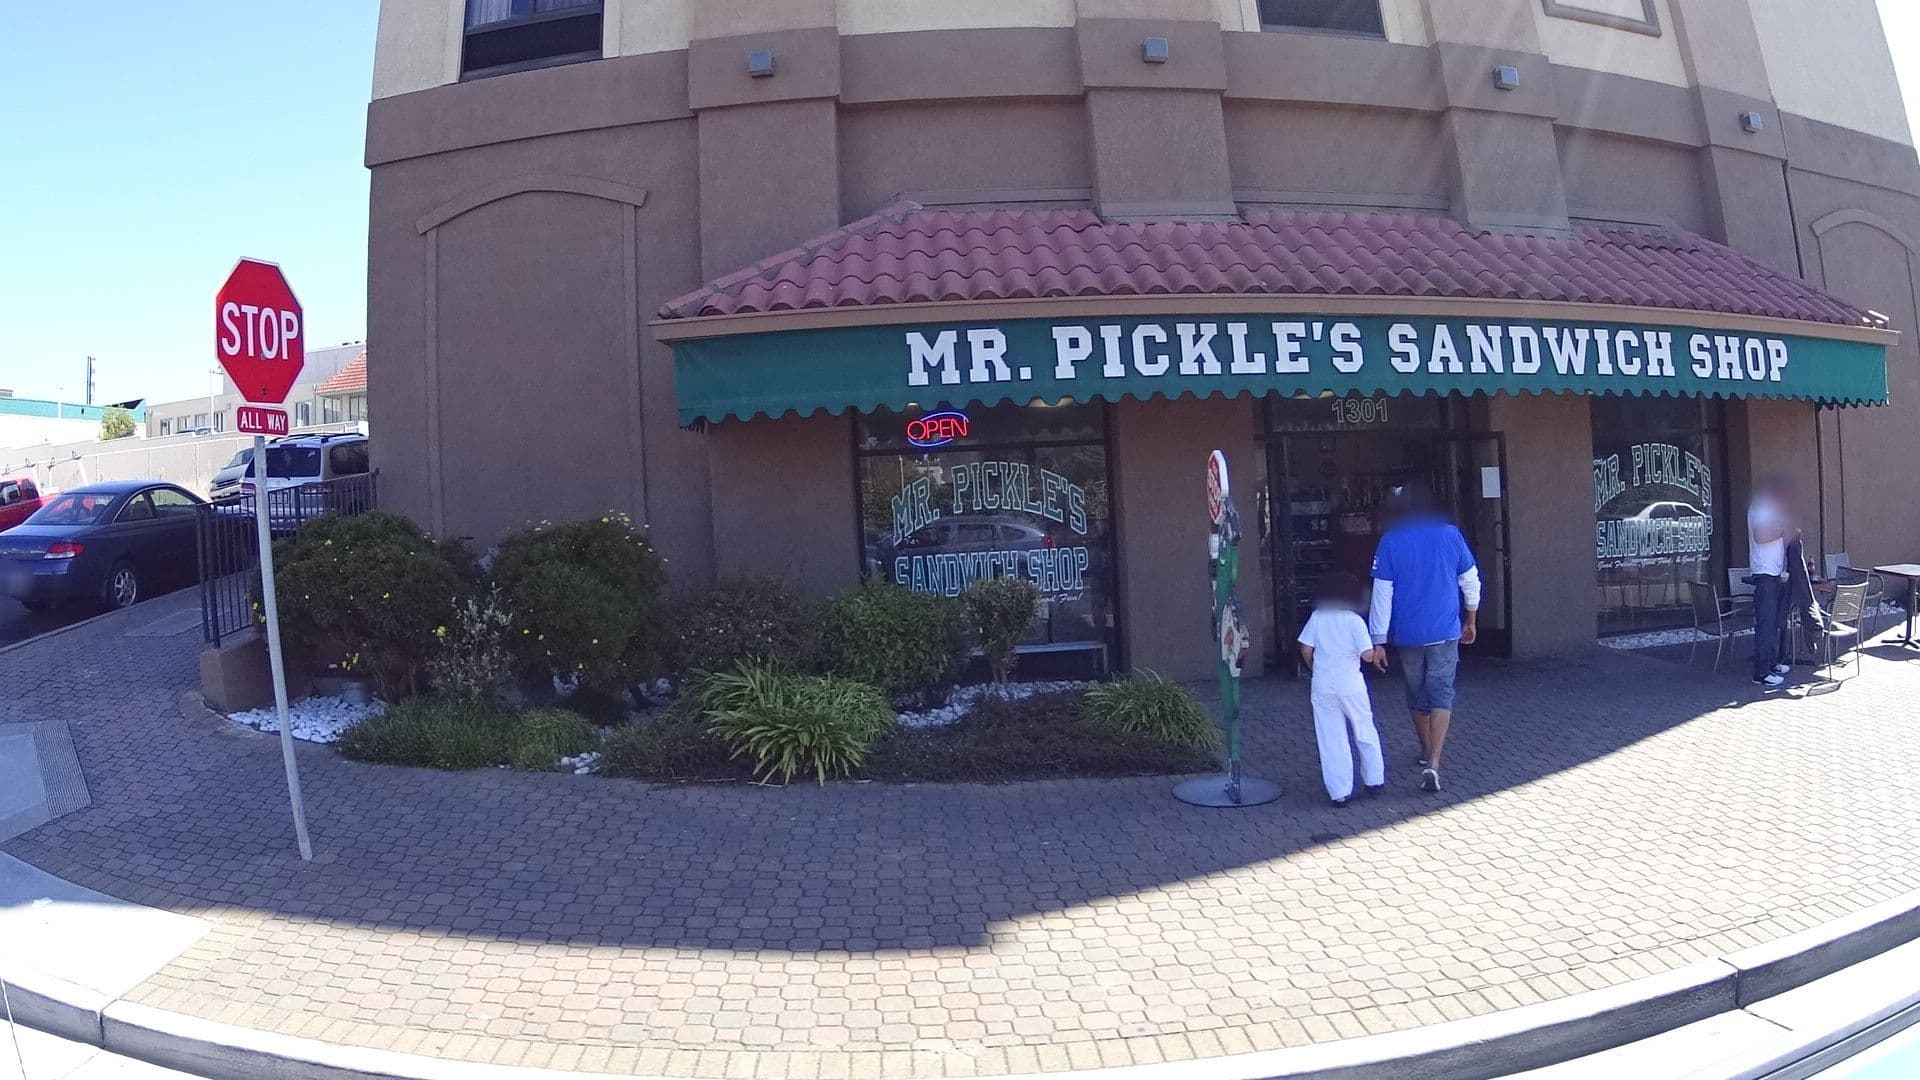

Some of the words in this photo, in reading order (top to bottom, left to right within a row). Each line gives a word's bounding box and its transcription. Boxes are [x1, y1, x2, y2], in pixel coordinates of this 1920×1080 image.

[221, 301, 299, 360] STOP
[905, 329, 1032, 386] MR.
[1051, 321, 1365, 380] PICKLE'S
[1387, 323, 1676, 377] SANDWICH
[1688, 333, 1789, 382] SHOP
[240, 411, 263, 430] ALL
[266, 412, 287, 432] WAY
[906, 417, 968, 440] OPEN
[1331, 398, 1390, 424] 1301
[1593, 452, 1626, 513] MR.
[1631, 442, 1712, 507] PICKLE'S
[891, 476, 941, 547] MR.
[951, 461, 1088, 536] PICKLE'S
[1596, 517, 1676, 559] SANDWICH
[1677, 515, 1713, 553] SHOP
[894, 550, 1020, 598] SANDWICH
[1026, 546, 1089, 592] SHOP
